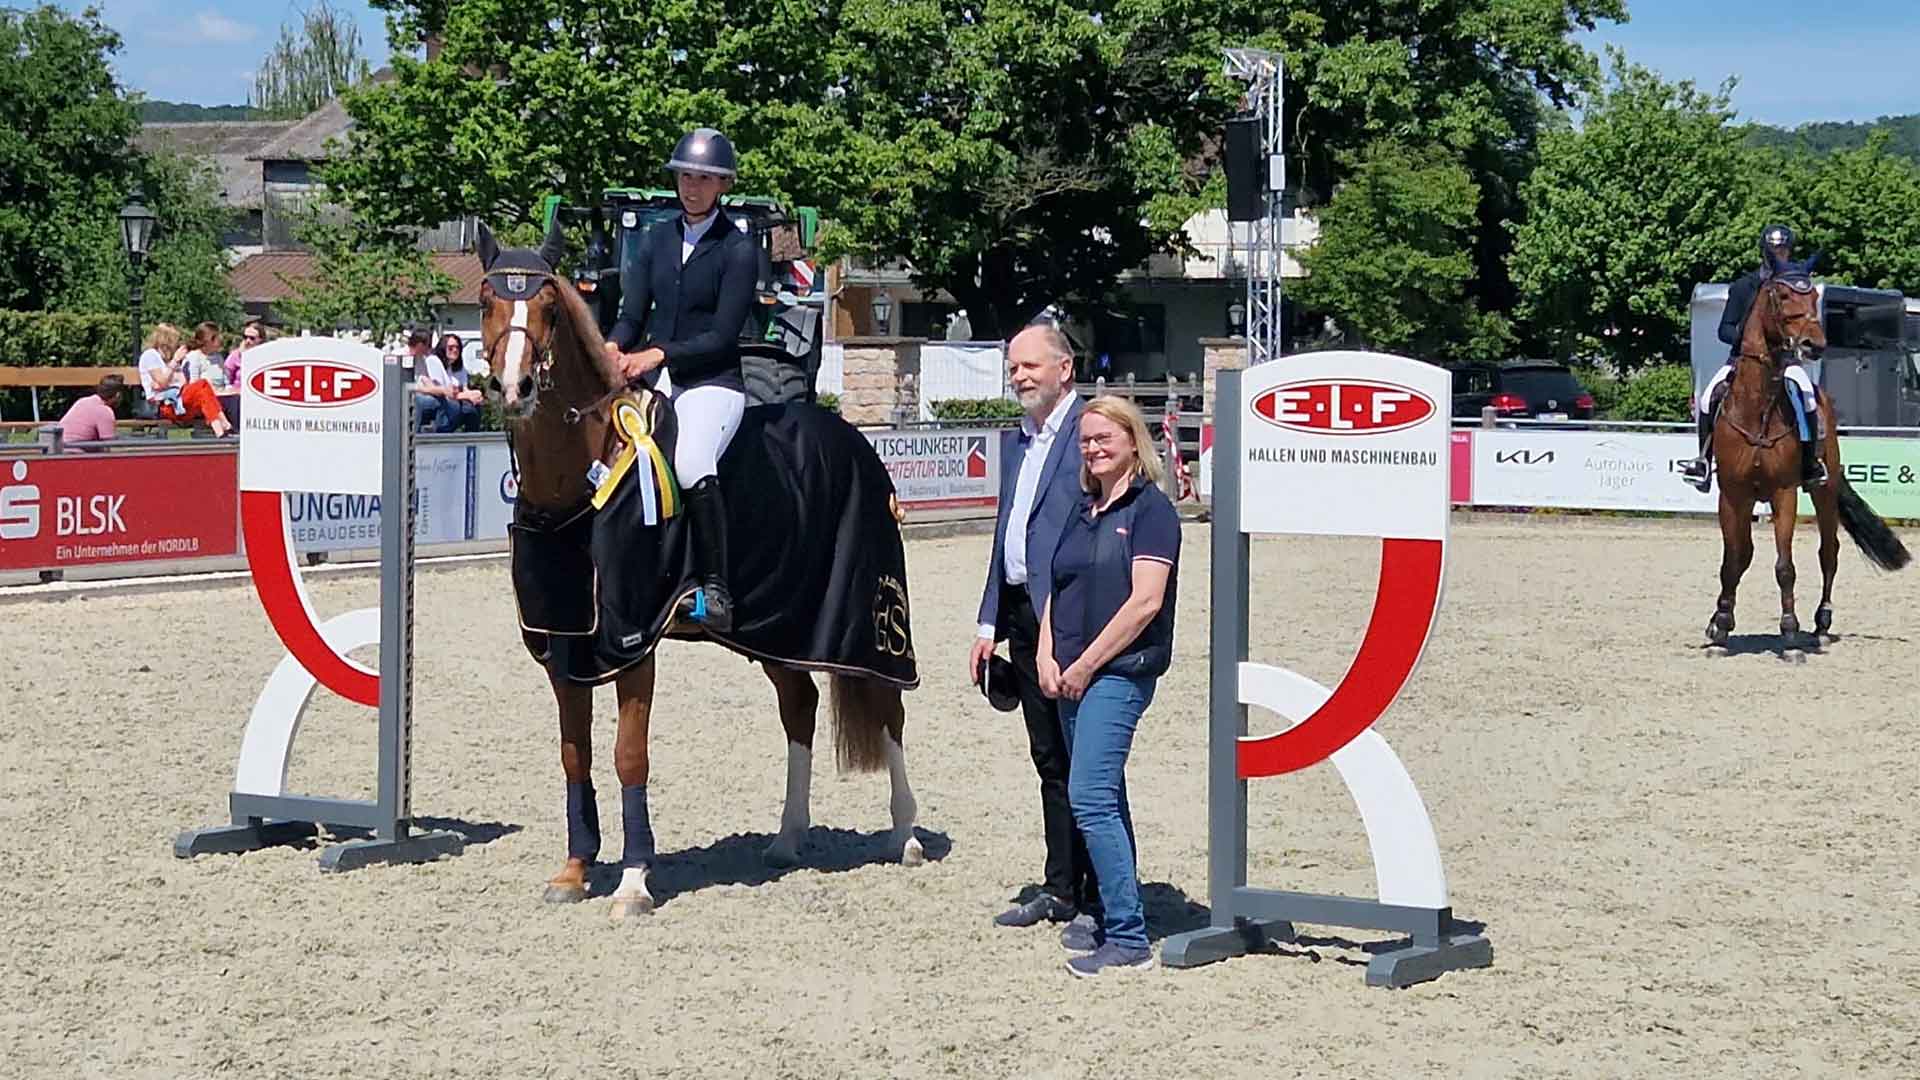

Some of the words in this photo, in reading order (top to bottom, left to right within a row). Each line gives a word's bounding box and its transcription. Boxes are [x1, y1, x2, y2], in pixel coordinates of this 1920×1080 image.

[246, 417, 279, 430] HALLEN
[283, 418, 301, 432] UND
[305, 419, 380, 433] MASCHINENBAU
[880, 436, 964, 456] TSCHUNKERT
[1249, 448, 1295, 462] HALLEN
[1301, 449, 1326, 463] UND
[1332, 450, 1437, 465] MASCHINENBAU
[1496, 450, 1554, 464] KIA
[1584, 457, 1653, 473] Autohaus
[938, 456, 965, 478] BÜRO
[1844, 464, 1890, 483] SE
[1898, 465, 1915, 483] &
[56, 495, 127, 535] BLSK
[56, 546, 72, 560] Ein
[75, 542, 138, 559] Unternehmen
[141, 540, 156, 554] der
[158, 537, 199, 553] NORD/LB
